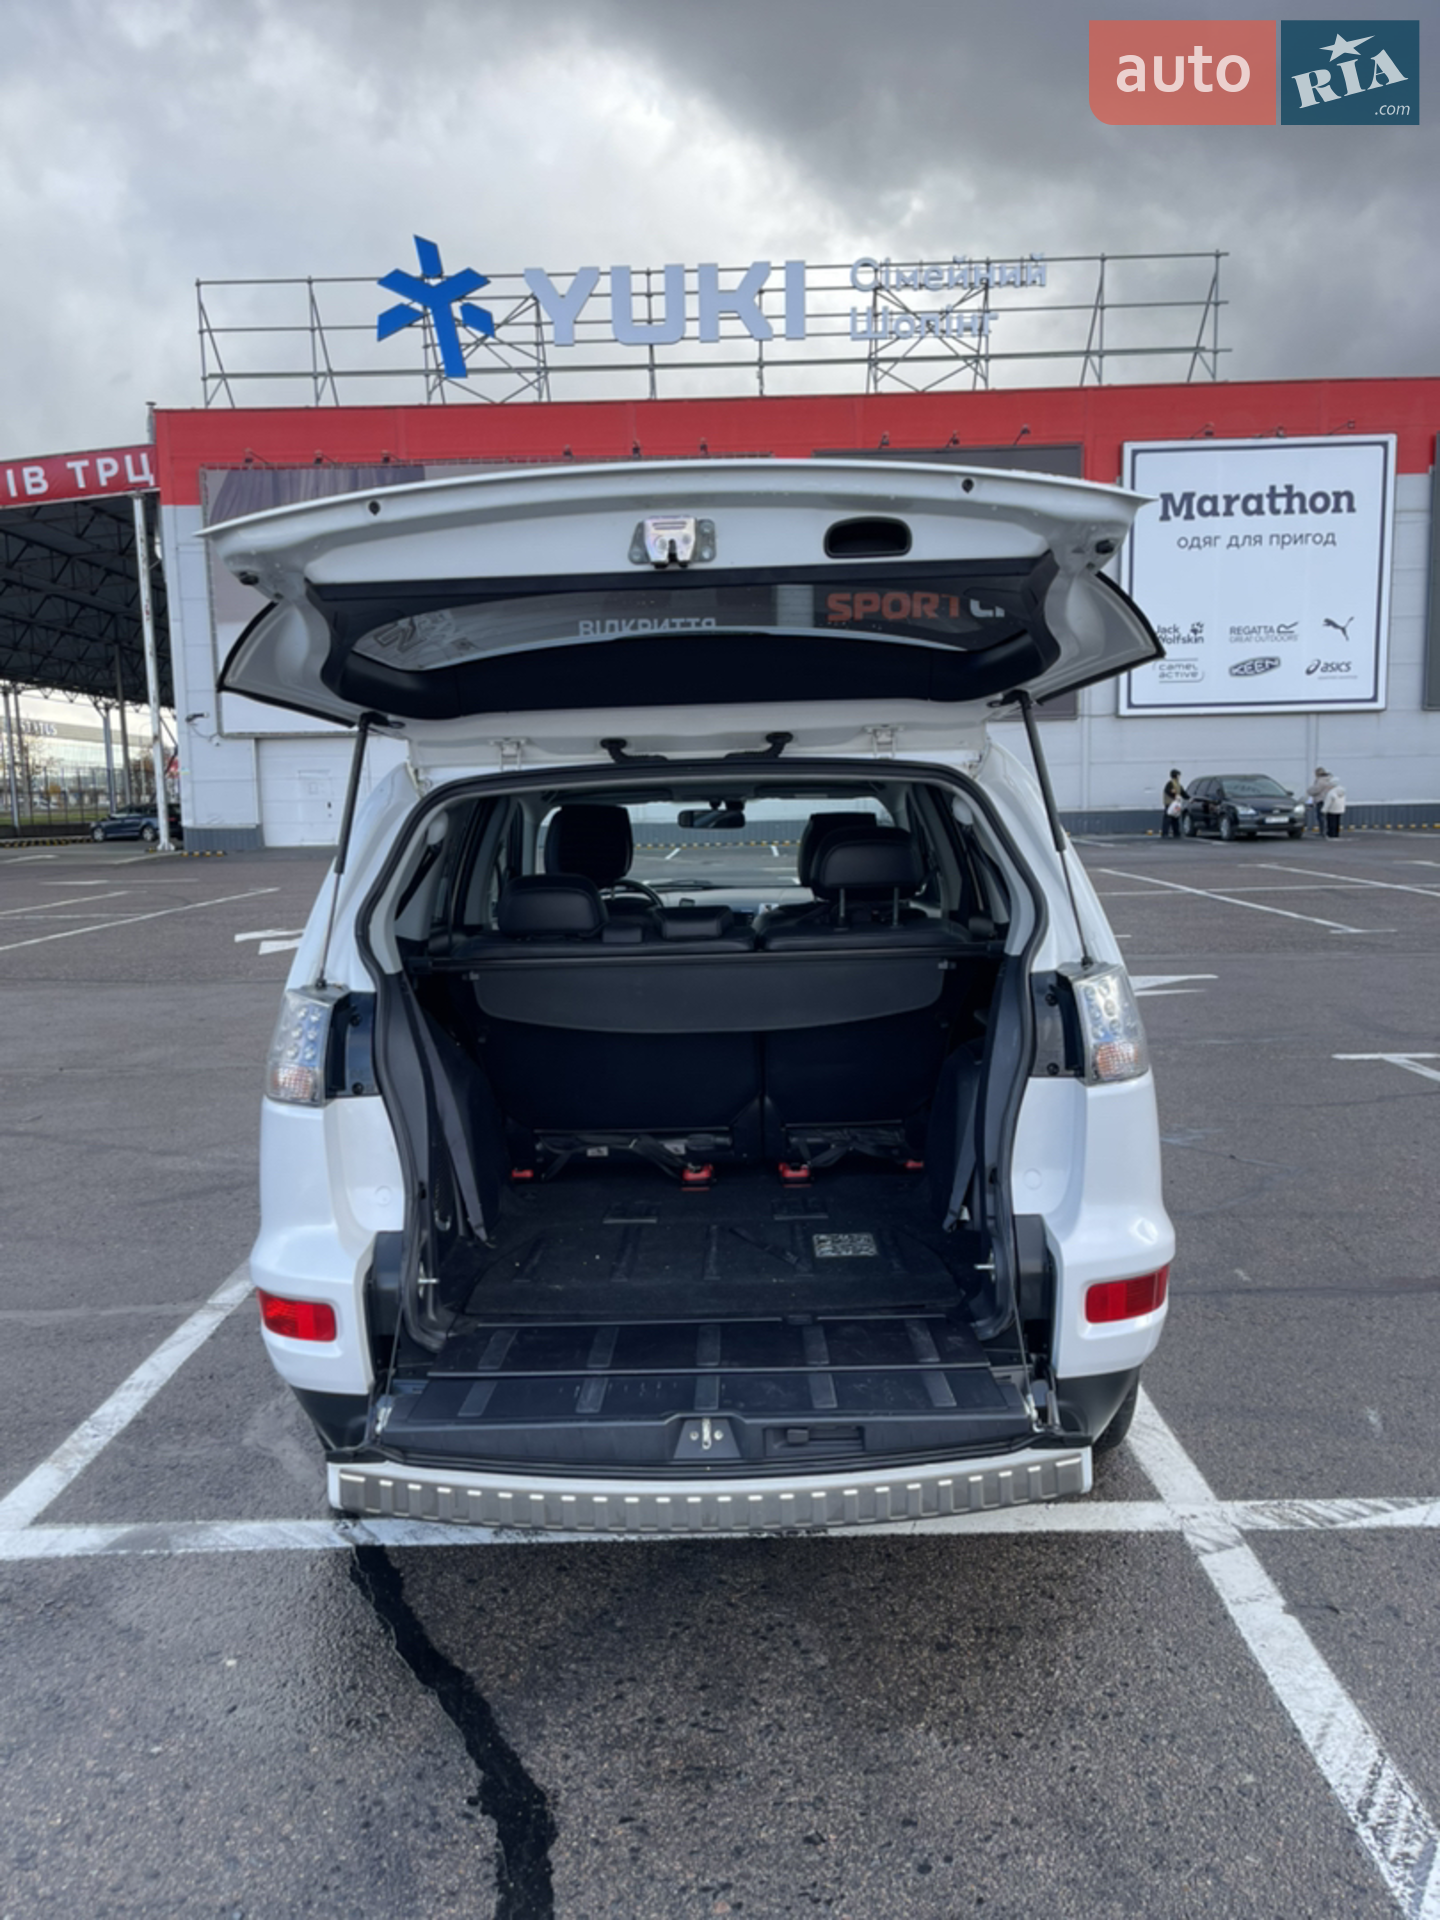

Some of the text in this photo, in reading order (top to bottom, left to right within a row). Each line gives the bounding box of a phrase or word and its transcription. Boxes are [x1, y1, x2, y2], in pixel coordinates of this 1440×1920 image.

[850, 253, 1047, 292] Сімейний
[524, 260, 806, 347] YUKI
[850, 305, 999, 341] Шопінг
[66, 453, 155, 489] ТРЦ
[1159, 484, 1357, 522] Marathon
[1177, 532, 1337, 551] одяг для пригод
[827, 591, 960, 622] SPORT
[1157, 624, 1180, 634] Jack
[1229, 626, 1275, 635] REGATTA
[1231, 659, 1279, 676] KEEN
